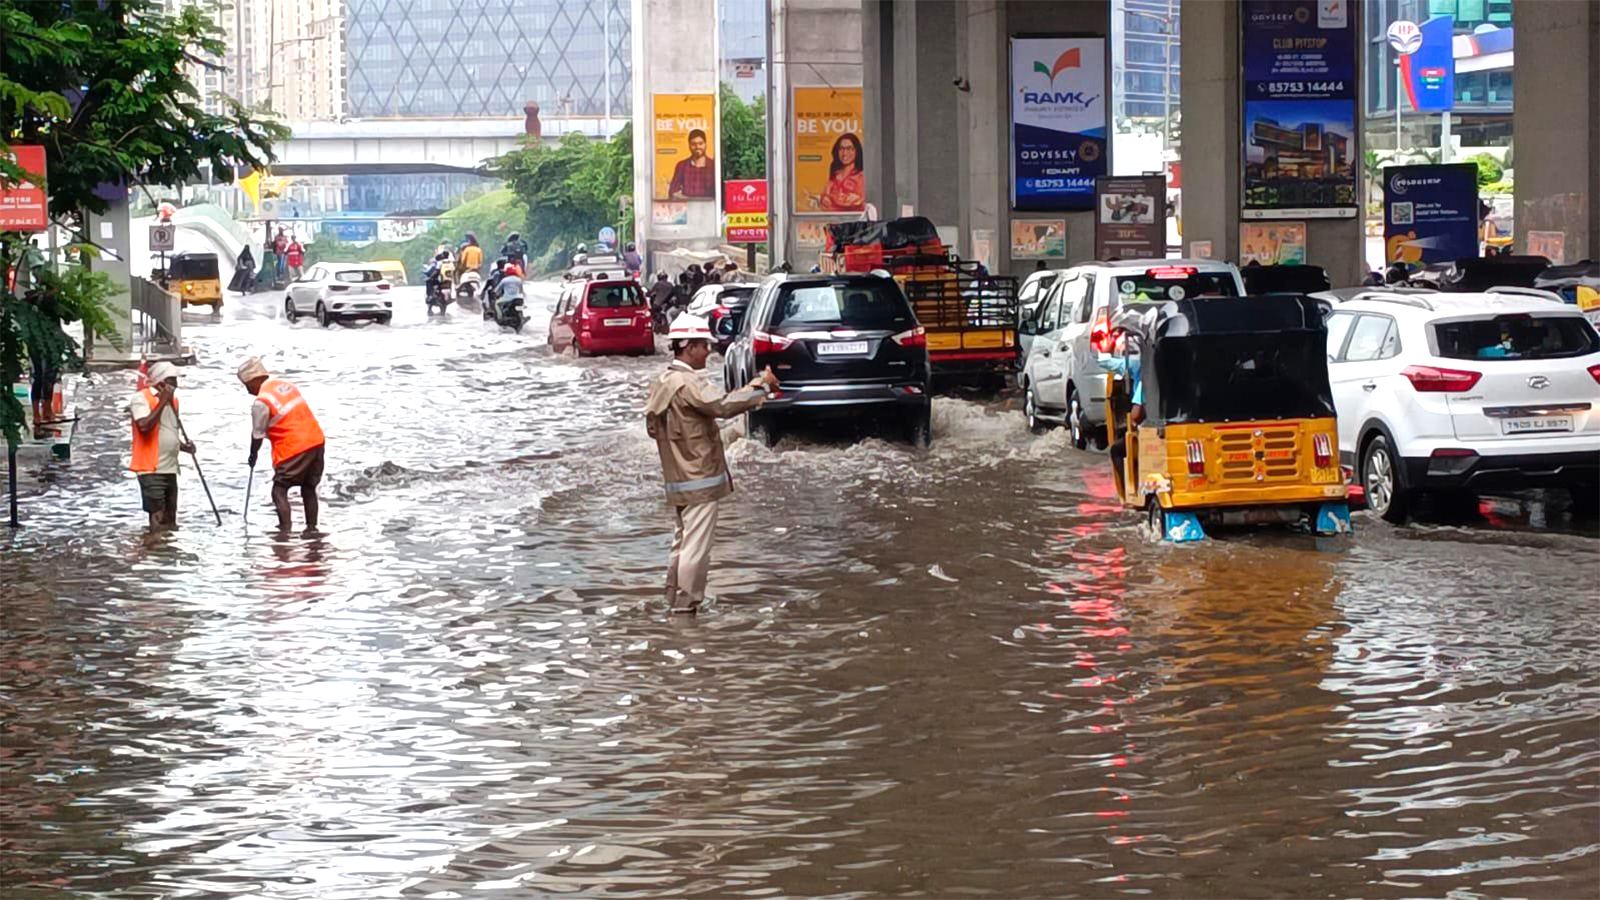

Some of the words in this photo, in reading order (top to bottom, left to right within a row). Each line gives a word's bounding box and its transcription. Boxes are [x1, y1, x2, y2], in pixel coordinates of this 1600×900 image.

[1398, 22, 1415, 35] HP
[1268, 82, 1304, 92] 85753
[1307, 81, 1344, 91] 14444
[797, 118, 817, 133] BE
[1021, 150, 1077, 160] ODYSSEY
